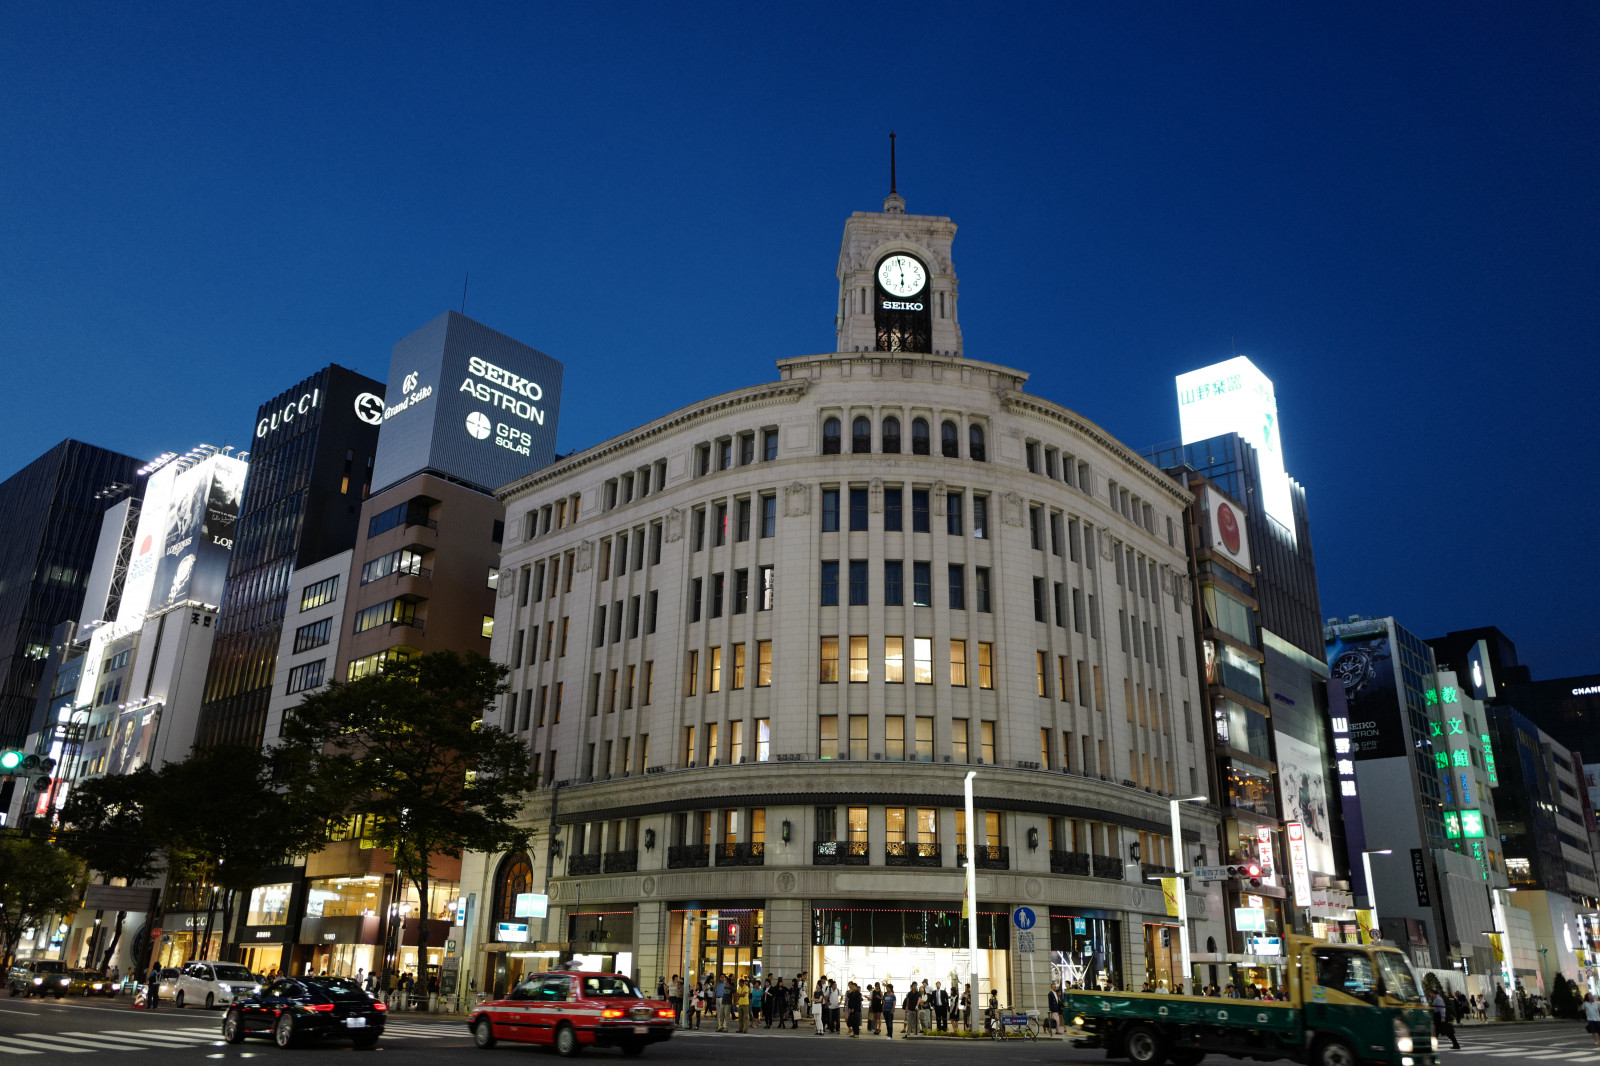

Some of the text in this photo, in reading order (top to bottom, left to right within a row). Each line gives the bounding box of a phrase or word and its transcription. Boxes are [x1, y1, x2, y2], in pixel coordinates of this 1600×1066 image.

[882, 301, 923, 311] SEIKO
[468, 356, 543, 401] SEIKO
[256, 388, 319, 439] GUCCI
[384, 385, 433, 420] Grand Seiko
[459, 377, 545, 426] ASTRON
[495, 436, 531, 457] SOLAR
[496, 422, 532, 447] GPS
[1349, 721, 1377, 731] EIKO
[1350, 728, 1380, 739] STRON
[1441, 686, 1469, 767] 教文館
[1414, 858, 1427, 897] ZENITH
